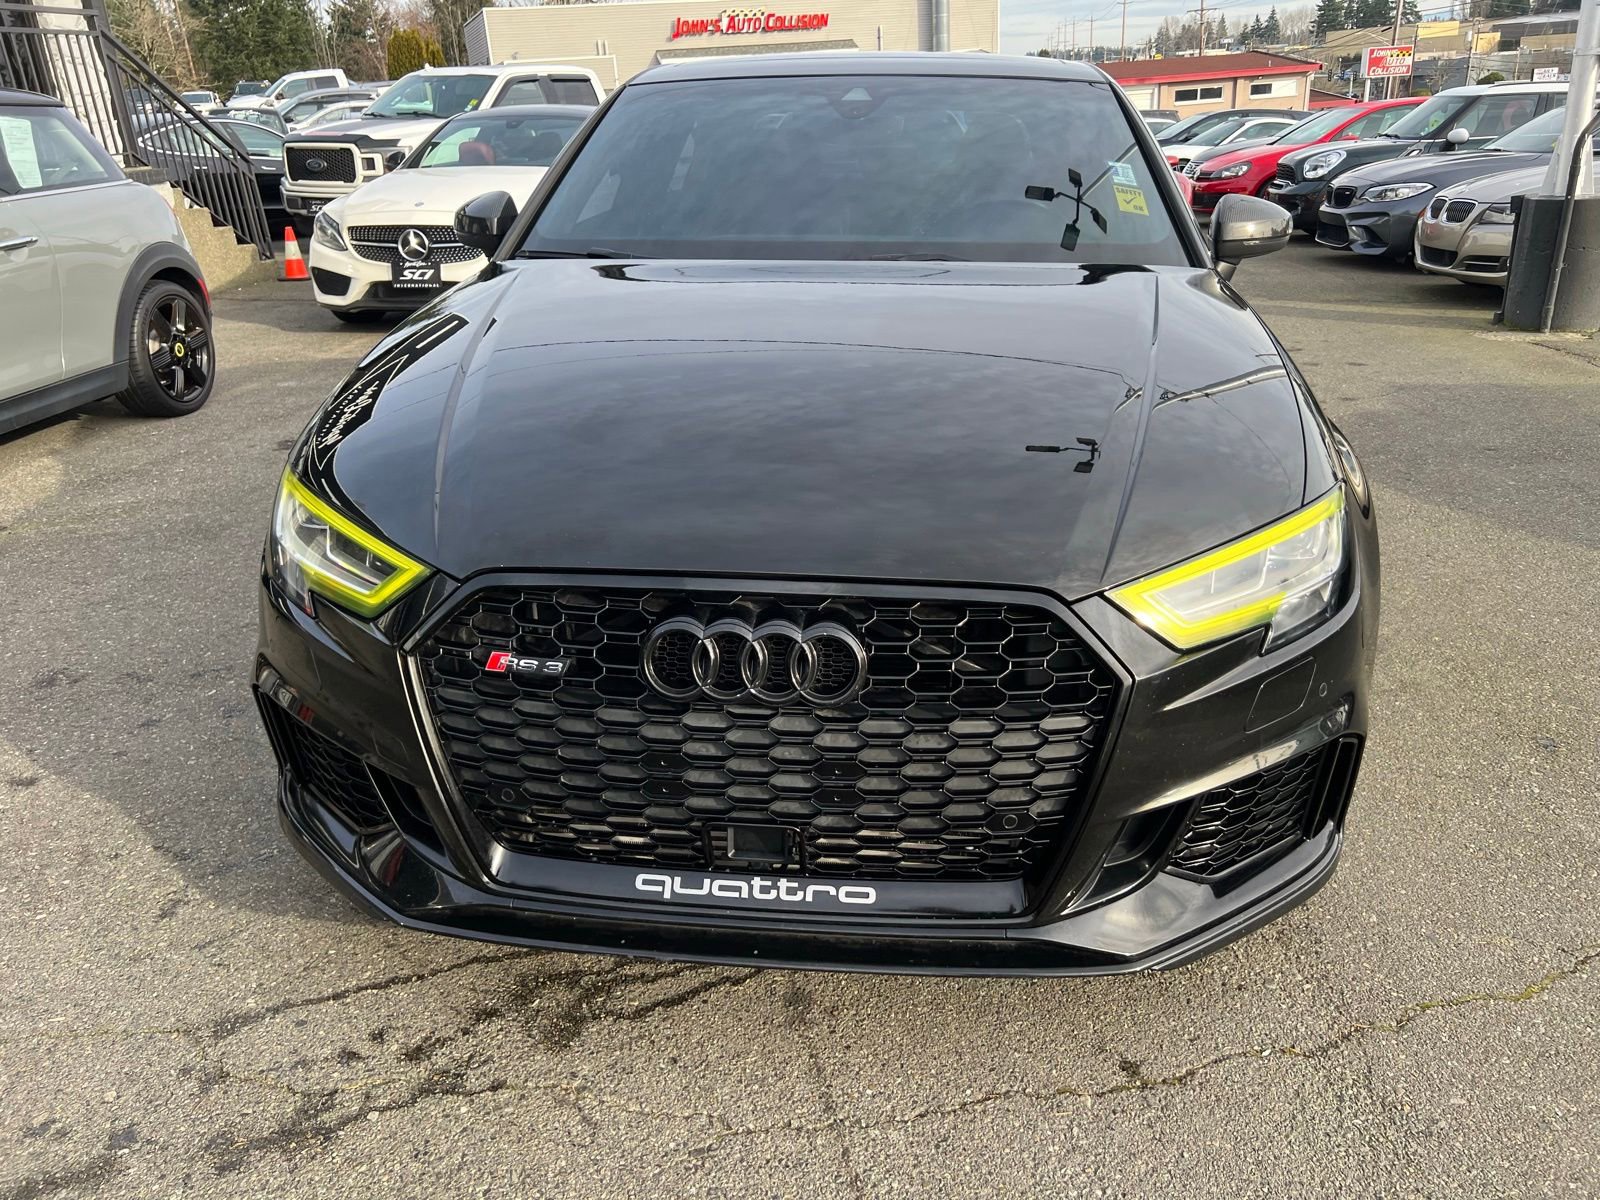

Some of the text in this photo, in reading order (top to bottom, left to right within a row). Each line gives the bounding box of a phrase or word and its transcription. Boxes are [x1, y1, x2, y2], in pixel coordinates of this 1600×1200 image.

[672, 13, 829, 40] JOHN'S AUTO COLLISION
[1379, 57, 1406, 67] AUTO
[1370, 65, 1408, 76] COLLISION
[399, 269, 435, 280] SCI
[500, 656, 564, 673] RS 3
[635, 873, 877, 905] quattro
